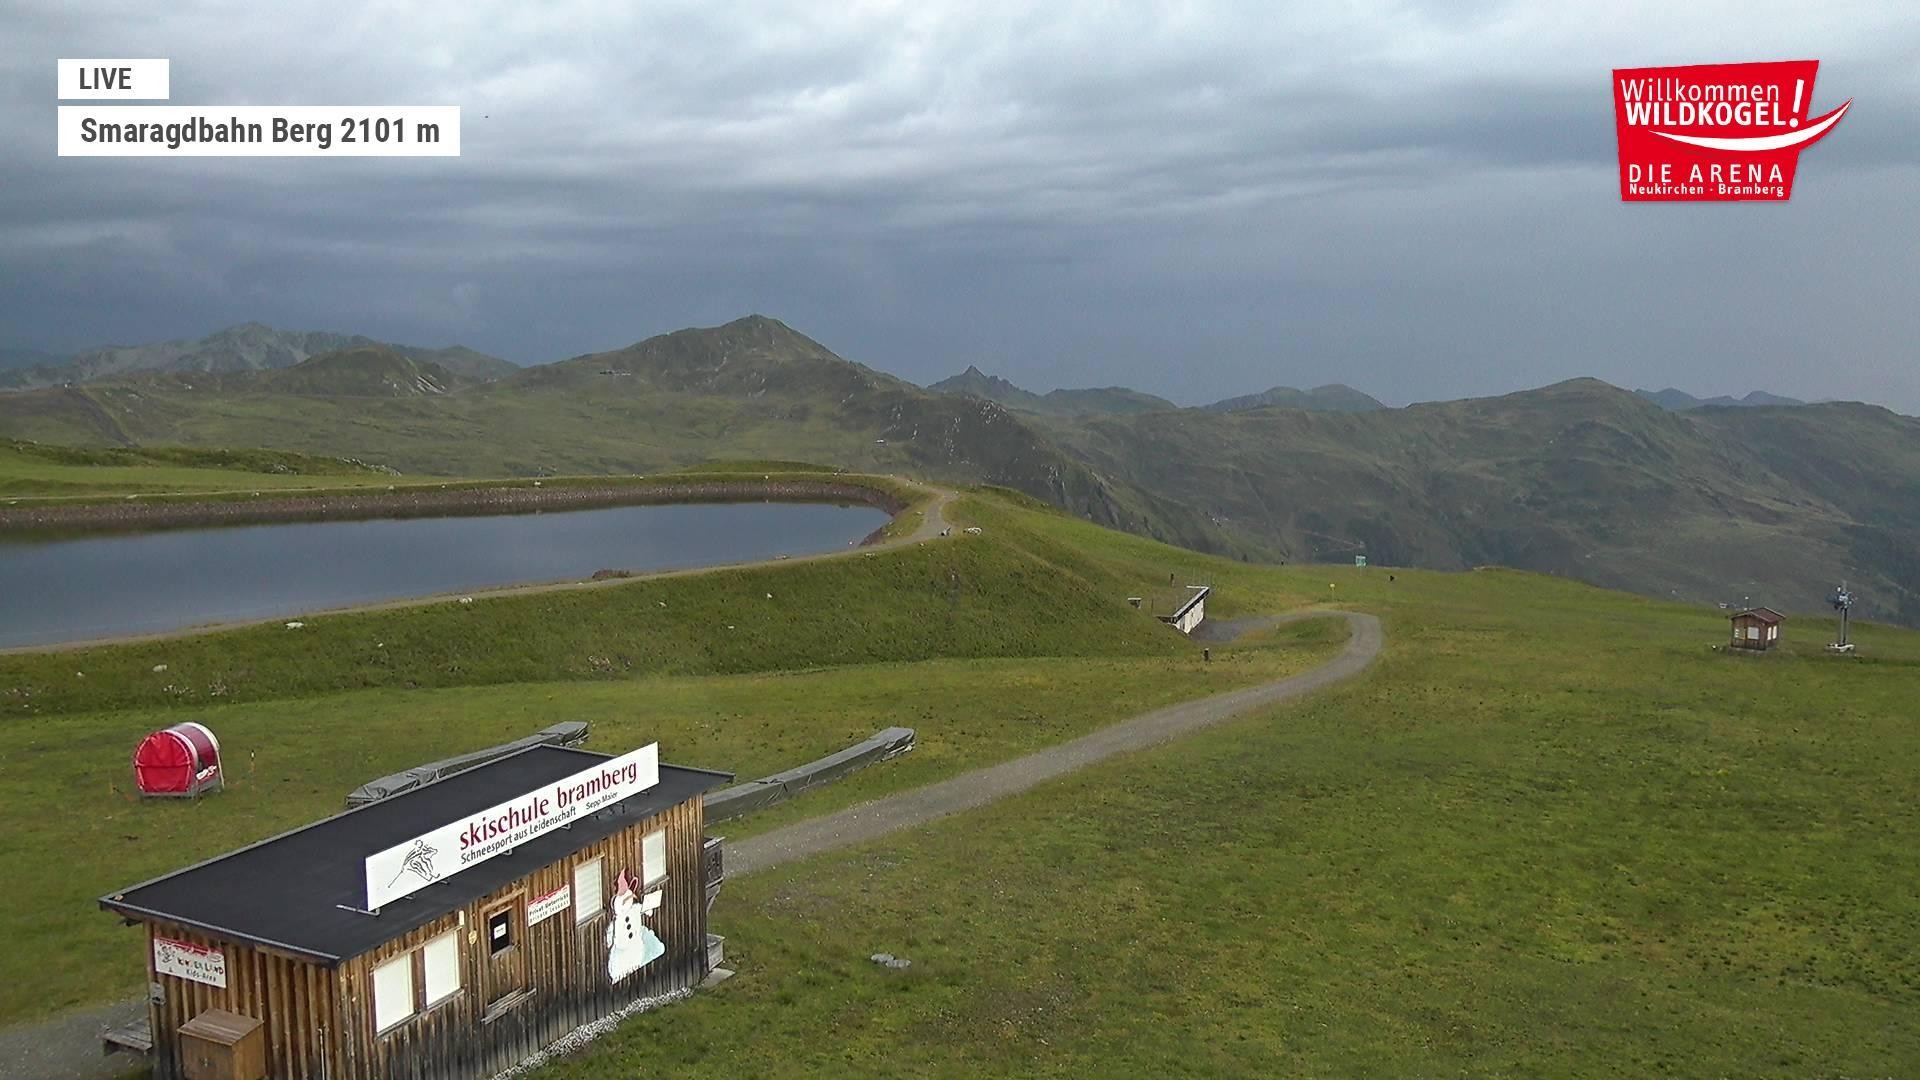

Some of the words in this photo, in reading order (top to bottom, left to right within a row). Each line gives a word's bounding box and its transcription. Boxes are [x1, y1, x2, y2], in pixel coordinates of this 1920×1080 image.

[460, 797, 550, 850] skischule
[557, 761, 637, 808] bramberg
[461, 834, 513, 865] Schneesport
[514, 829, 528, 841] aus
[529, 806, 577, 835] Leidenschaft
